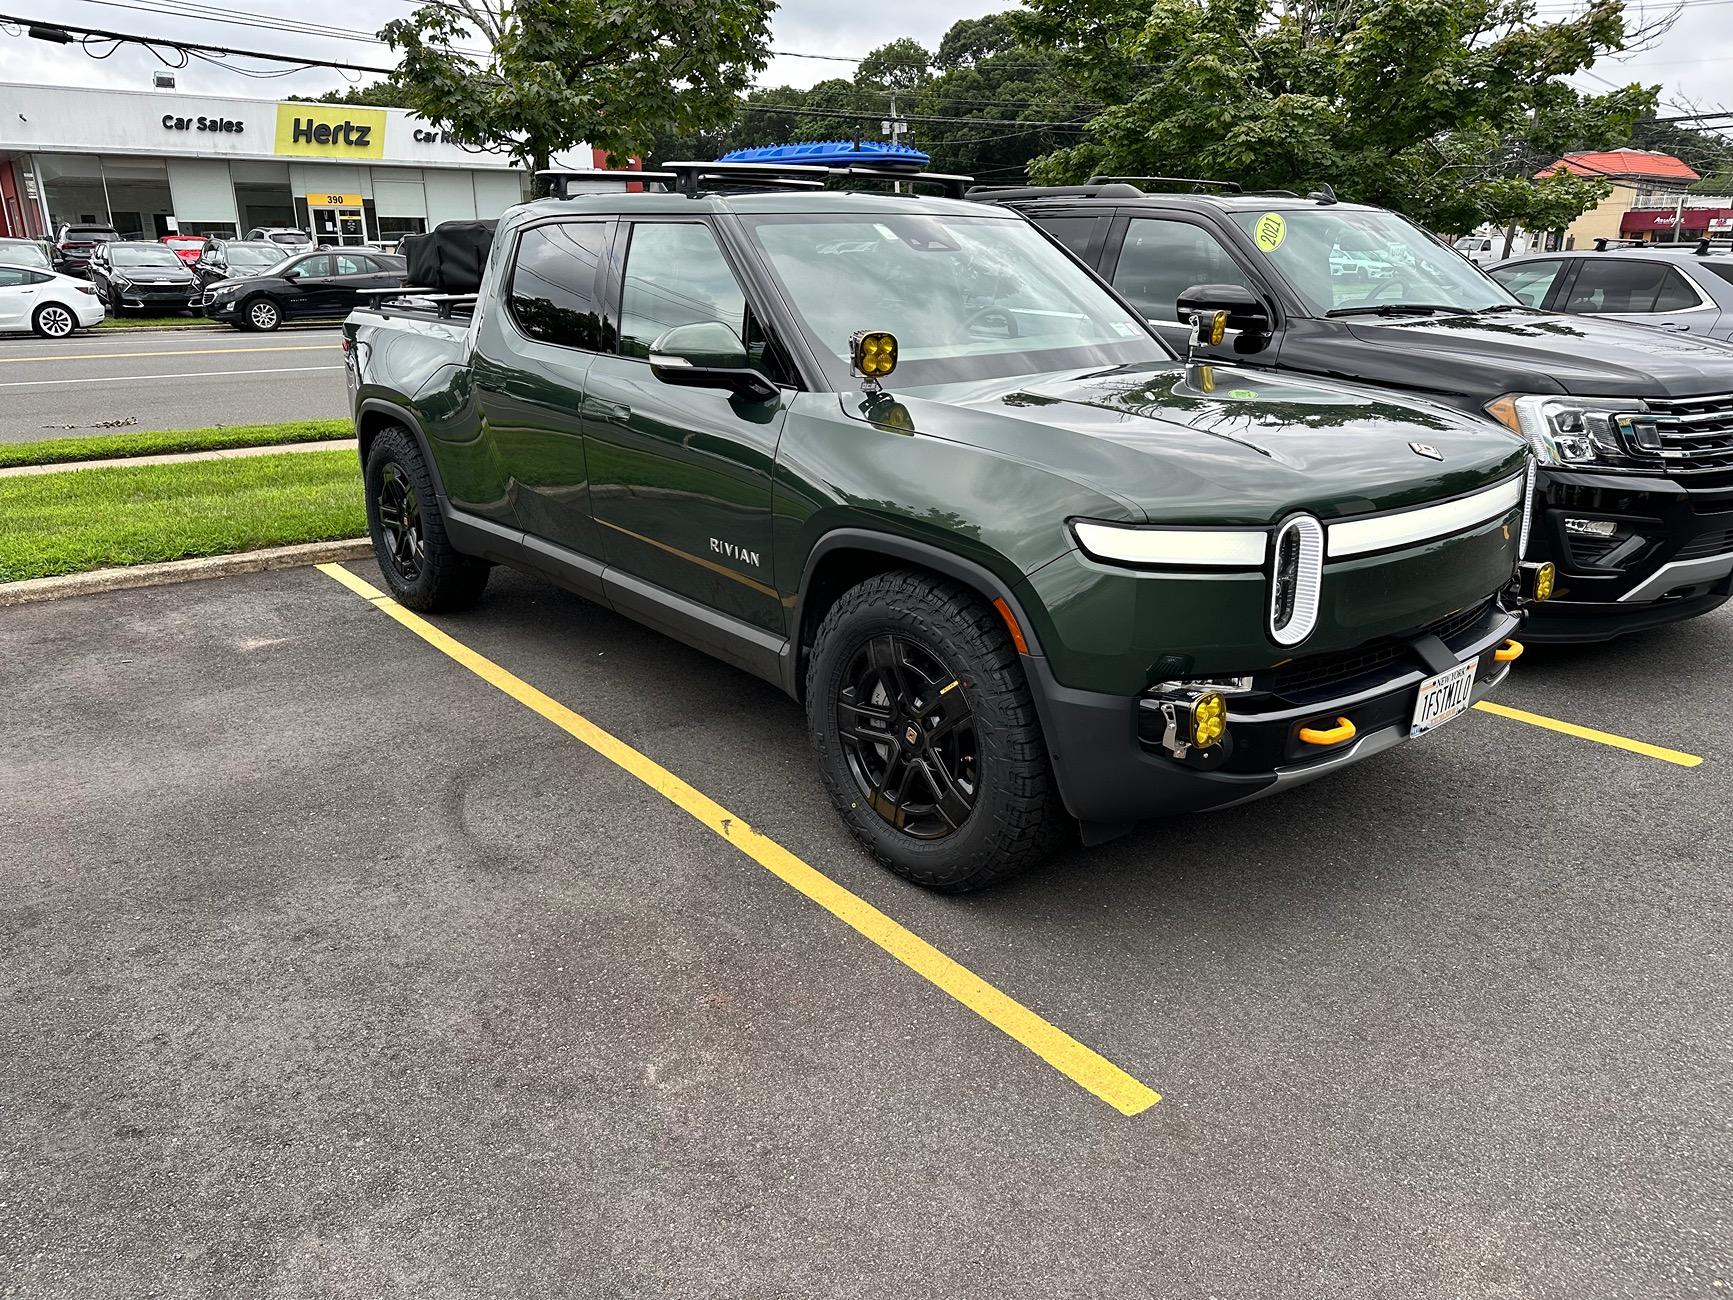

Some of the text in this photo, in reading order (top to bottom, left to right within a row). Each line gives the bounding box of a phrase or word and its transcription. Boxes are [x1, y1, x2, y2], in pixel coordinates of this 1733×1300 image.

[162, 114, 244, 133] Car Sales
[292, 117, 371, 146] Hertz
[413, 129, 439, 143] Car
[327, 195, 344, 204] 390
[1260, 216, 1281, 247] 2021
[709, 537, 760, 567] RIVIAN
[1421, 674, 1472, 722] 1FSTMILO
